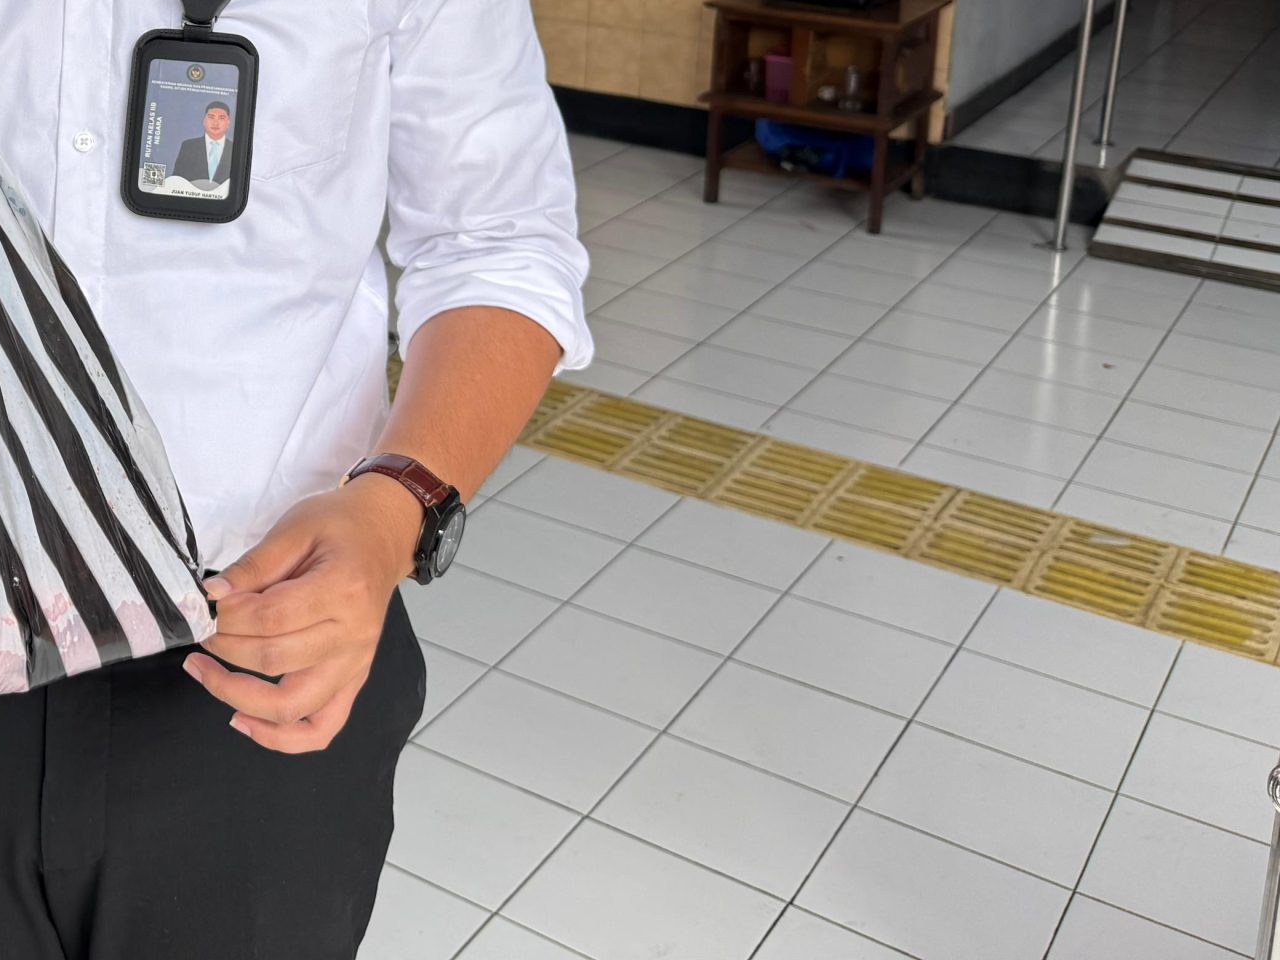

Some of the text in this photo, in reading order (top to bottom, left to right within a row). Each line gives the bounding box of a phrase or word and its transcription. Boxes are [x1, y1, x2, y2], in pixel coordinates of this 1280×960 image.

[148, 112, 156, 134] KELAS
[154, 116, 162, 144] NEGARA
[145, 135, 153, 158] RUTAN
